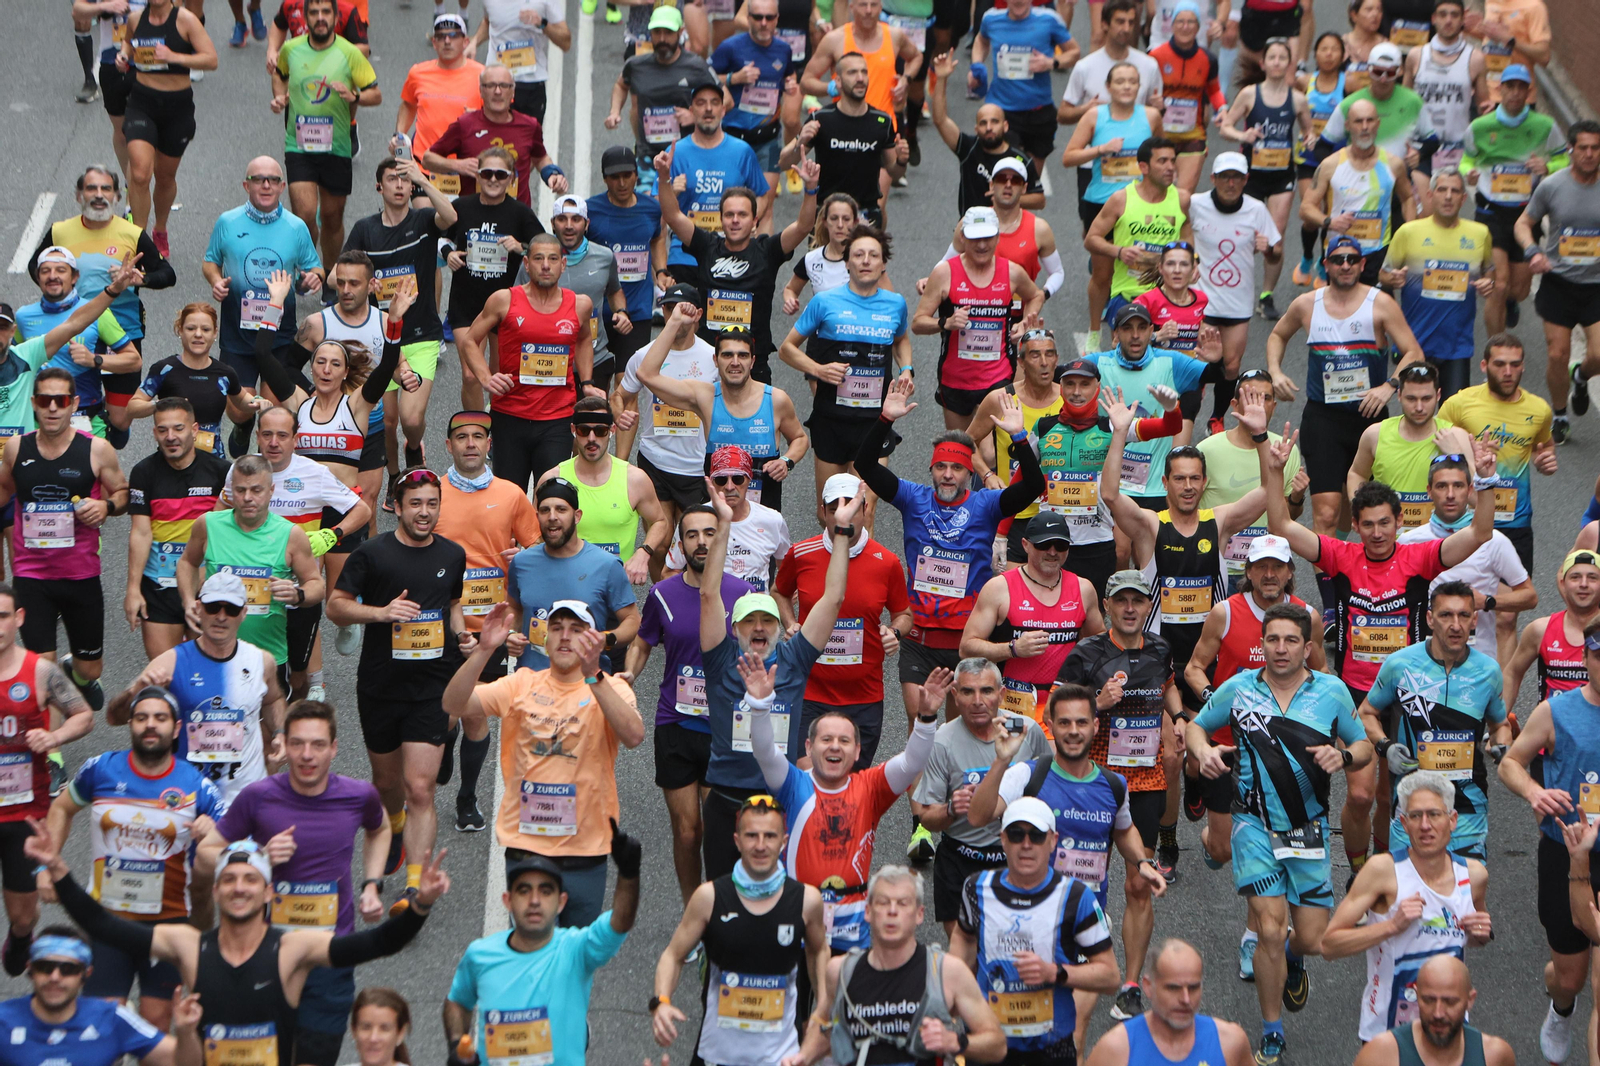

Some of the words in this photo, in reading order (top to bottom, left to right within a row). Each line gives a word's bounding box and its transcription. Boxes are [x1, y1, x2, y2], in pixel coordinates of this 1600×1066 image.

[830, 138, 878, 152] Daralux
[481, 222, 498, 234] ME
[1129, 222, 1176, 236] Deluxe
[1440, 262, 1466, 270] ZURICH
[384, 268, 411, 277] ZURICH
[722, 290, 748, 300] ZURICH
[720, 304, 736, 312] 5554
[974, 321, 998, 330] ZURICH
[536, 359, 553, 367] 4739
[1337, 360, 1363, 370] ZURICH
[855, 368, 881, 376] ZURICH
[1122, 452, 1148, 461] ZURICH
[1122, 465, 1134, 473] 882
[1064, 473, 1093, 481] ZURICH
[188, 487, 213, 496] 226ERS
[1063, 487, 1080, 495] 6122
[38, 503, 68, 511] ZURICH
[1243, 528, 1270, 536] ZURICH
[936, 550, 965, 561] ZURICH
[236, 568, 267, 576] ZURICH
[933, 564, 951, 574] 7950
[471, 570, 499, 578] ZURICH
[927, 576, 954, 586] CASTILLO
[1179, 578, 1208, 587] ZURICH
[471, 585, 489, 594] 5064
[1178, 594, 1196, 602] 5887
[1022, 620, 1059, 628] atletismo
[1061, 620, 1076, 628] club
[1370, 616, 1400, 625] ZURICH
[411, 629, 430, 638] 5066
[1369, 633, 1388, 642] 6084
[205, 712, 238, 720] ZURICH
[1130, 719, 1157, 727] ZURICH
[1128, 735, 1147, 743] 7267
[1437, 732, 1469, 740] ZURICH
[1436, 749, 1456, 757] 4762
[536, 786, 569, 795] ZURICH
[1064, 808, 1112, 824] efectoLED
[1078, 840, 1106, 850] ZURICH
[123, 862, 159, 871] ZURICH
[294, 883, 331, 893] ZURICH
[742, 978, 779, 988] ZURICH
[504, 1010, 541, 1021] ZURICH
[228, 1026, 270, 1039] ZURICH
